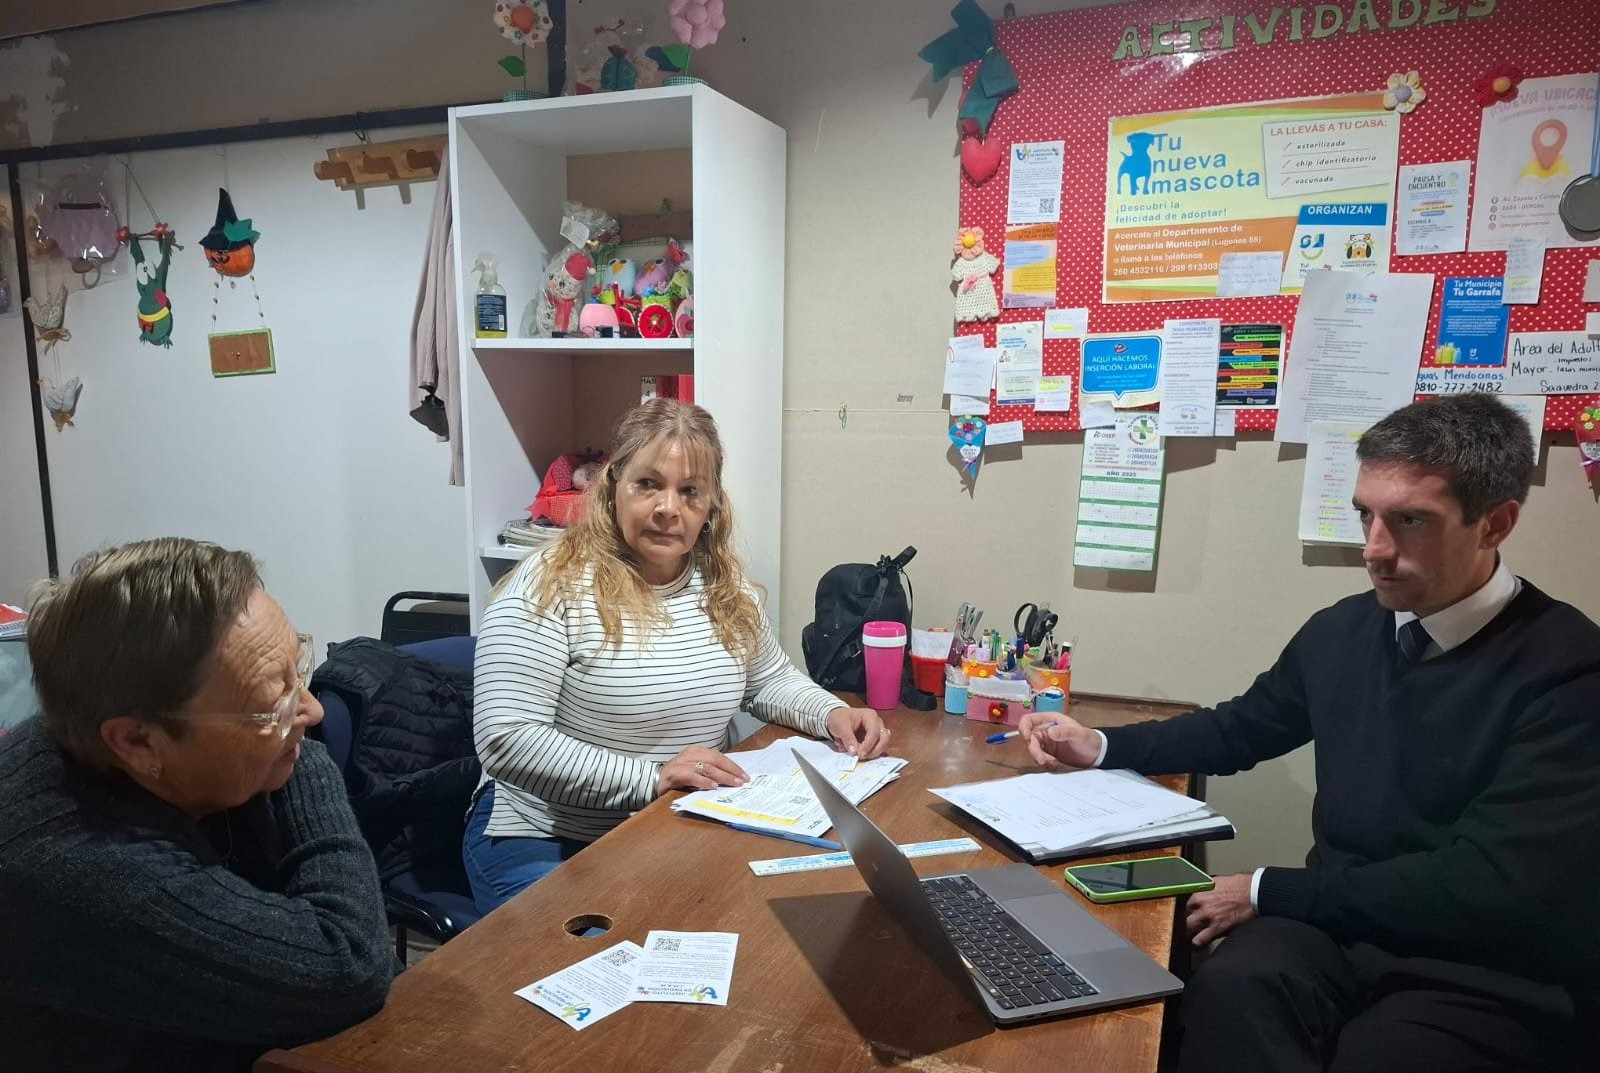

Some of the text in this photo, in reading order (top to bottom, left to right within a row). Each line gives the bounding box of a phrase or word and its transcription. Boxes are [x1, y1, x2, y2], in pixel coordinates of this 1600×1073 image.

[1113, 0, 1497, 60] ACTIVIDADES
[1544, 87, 1596, 101] UBICAC
[1270, 119, 1388, 137] LA LLEVÁS A TU CASA:
[1154, 132, 1182, 153] Tu
[1296, 140, 1346, 151] esterilizada
[1152, 152, 1227, 173] nueva
[1295, 154, 1377, 168] chip identificatorio
[1151, 168, 1261, 195] mascota
[1295, 175, 1334, 185] vacunada
[1408, 180, 1446, 191] ENCUENTRO
[1413, 175, 1435, 184] PAUSA
[1170, 201, 1180, 209] la
[1307, 204, 1373, 215] ORGANIZAN
[1115, 208, 1227, 224] felicidad de adoptar!
[1153, 230, 1161, 238] al
[1162, 226, 1229, 239] Departamento
[1230, 224, 1243, 233] de
[1114, 240, 1164, 252] Veterinaria
[1165, 239, 1210, 250] Municipal
[1151, 252, 1163, 261] los
[1187, 262, 1220, 273] 513303
[1454, 279, 1502, 288] Tu Municipio
[1453, 287, 1501, 297] Tu Garrafa
[1547, 343, 1563, 354] del
[1111, 354, 1149, 363] HACEMOS
[1417, 370, 1439, 383] guas
[1540, 379, 1589, 393] Saavedra
